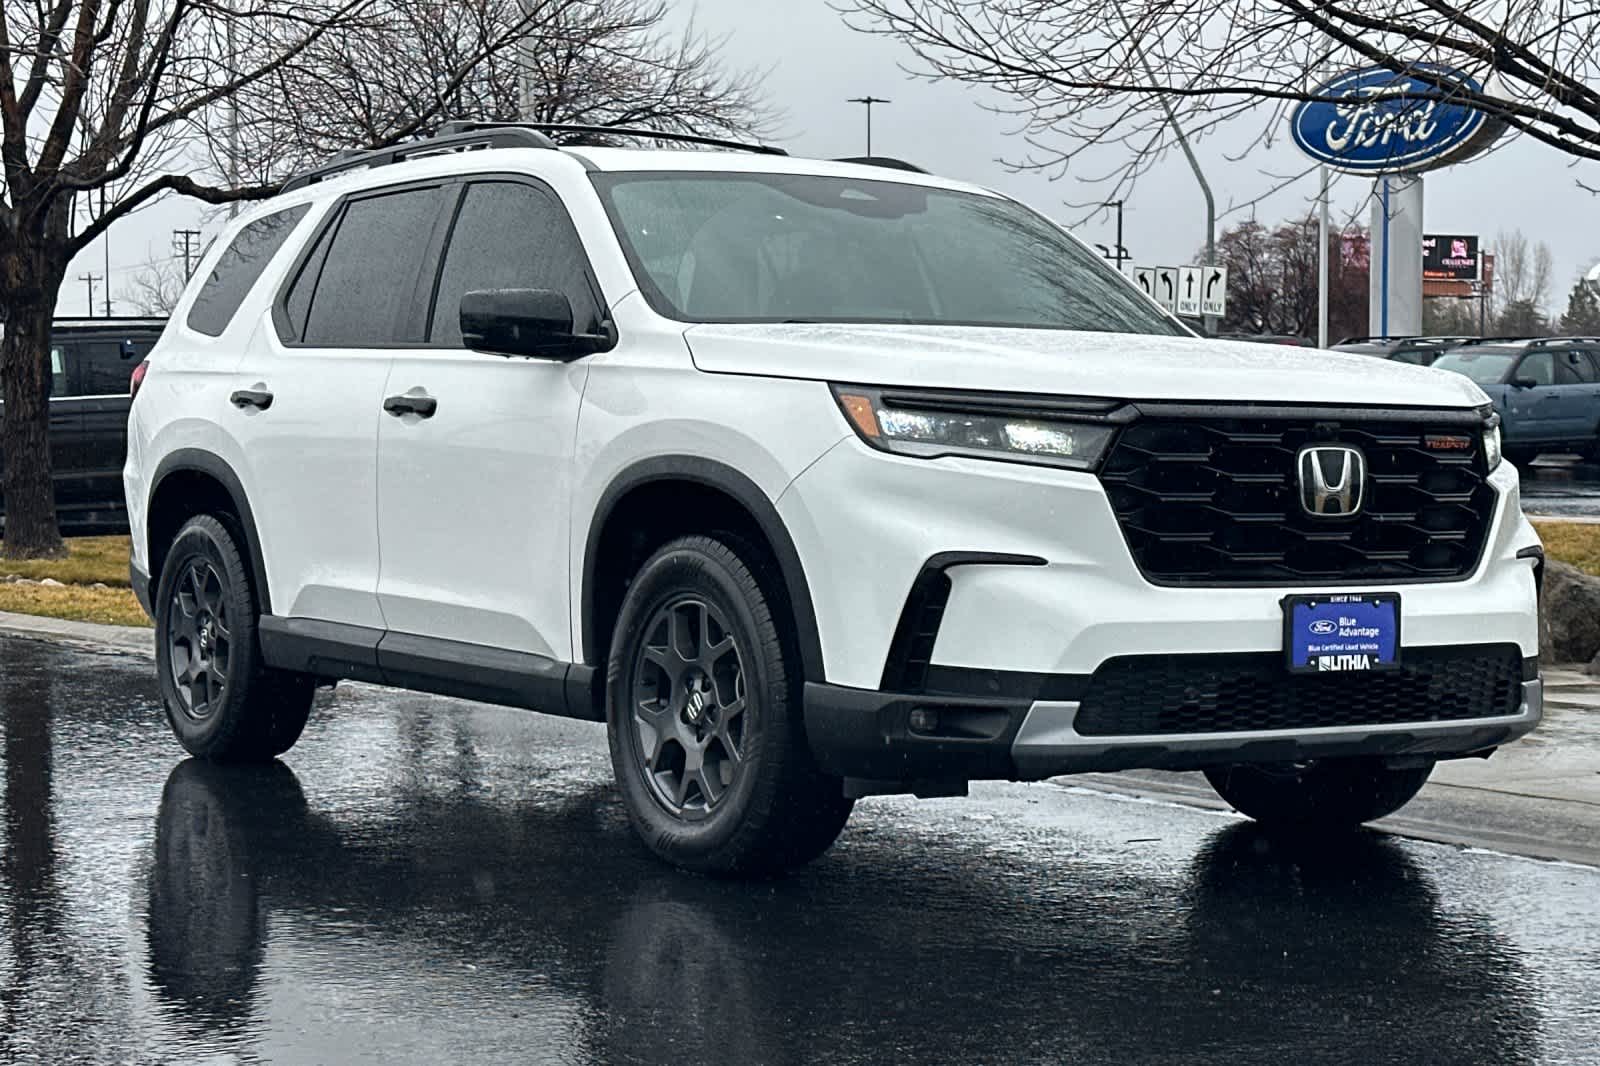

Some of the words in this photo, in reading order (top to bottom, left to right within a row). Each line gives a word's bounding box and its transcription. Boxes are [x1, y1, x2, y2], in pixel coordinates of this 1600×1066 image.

[1325, 82, 1437, 150] Ford
[1180, 302, 1197, 312] ONLY
[1203, 303, 1222, 312] ONLY
[1339, 617, 1357, 626] Blue
[1339, 628, 1380, 638] Advantage
[1331, 655, 1370, 671] LITHIA
